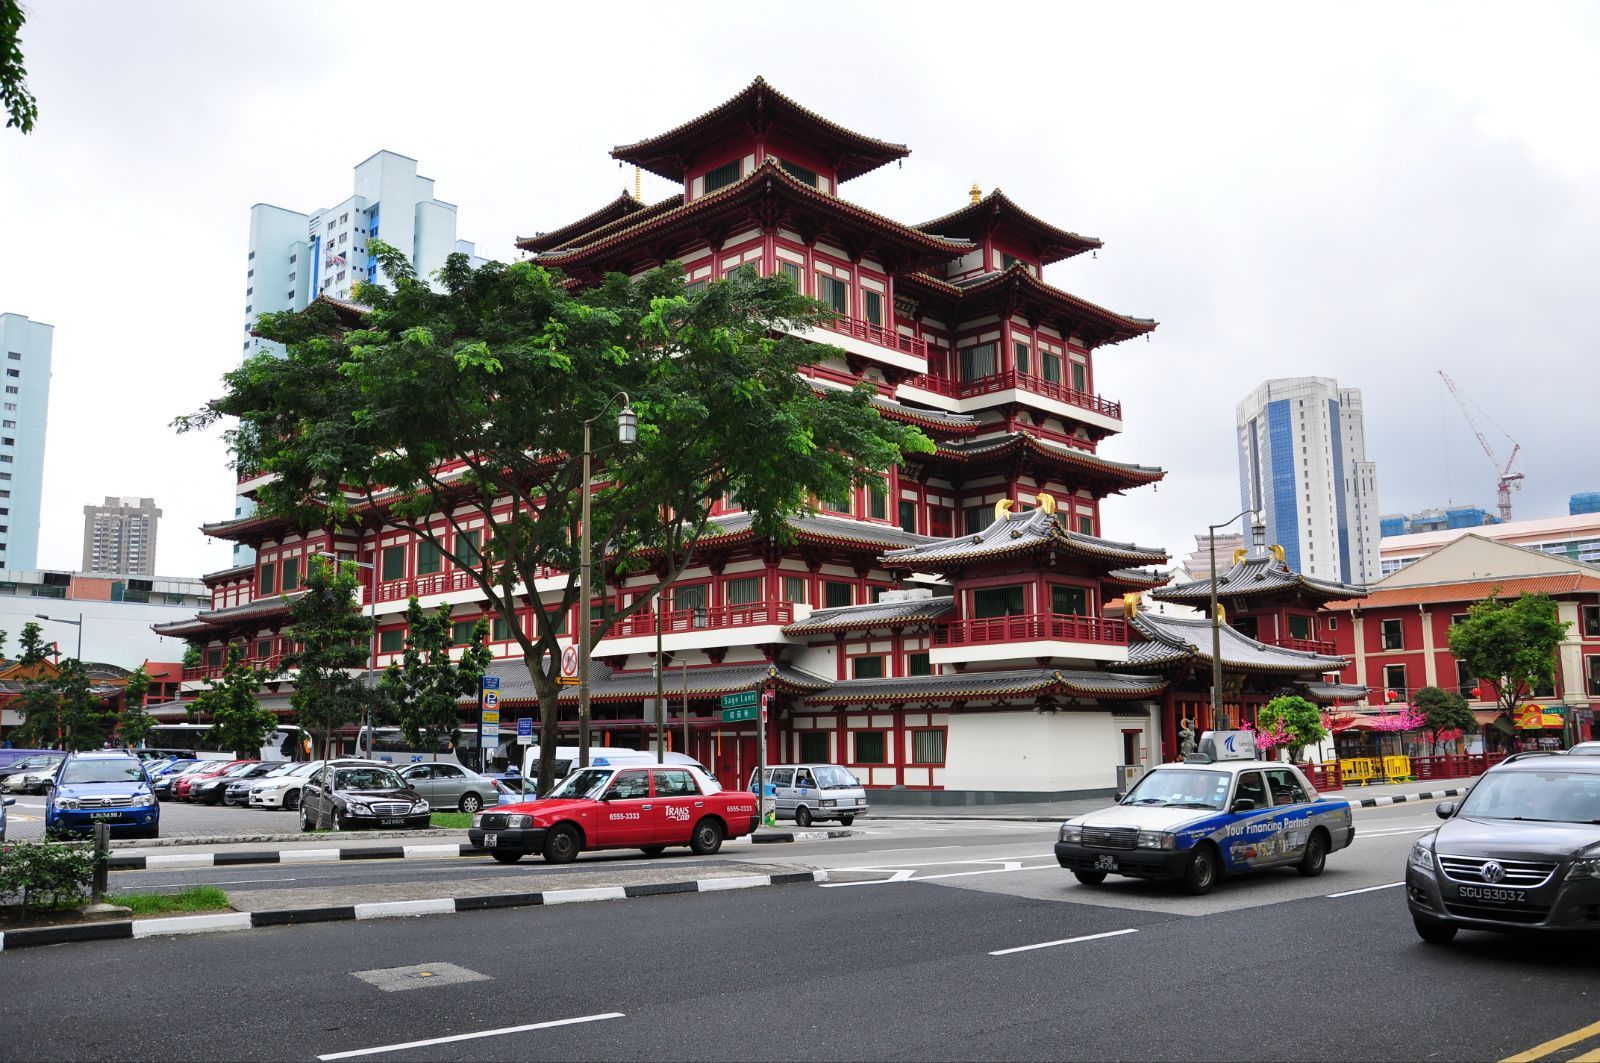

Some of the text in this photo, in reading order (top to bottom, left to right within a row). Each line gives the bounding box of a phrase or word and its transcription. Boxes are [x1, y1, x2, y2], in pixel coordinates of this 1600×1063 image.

[724, 694, 755, 705] Sago Lane
[664, 805, 690, 816] TRANS
[1224, 824, 1244, 837] Your
[1246, 820, 1282, 833] Financing
[1283, 817, 1310, 830] Partner
[1099, 854, 1113, 863] SHB
[1459, 886, 1525, 902] SGU9303Z
